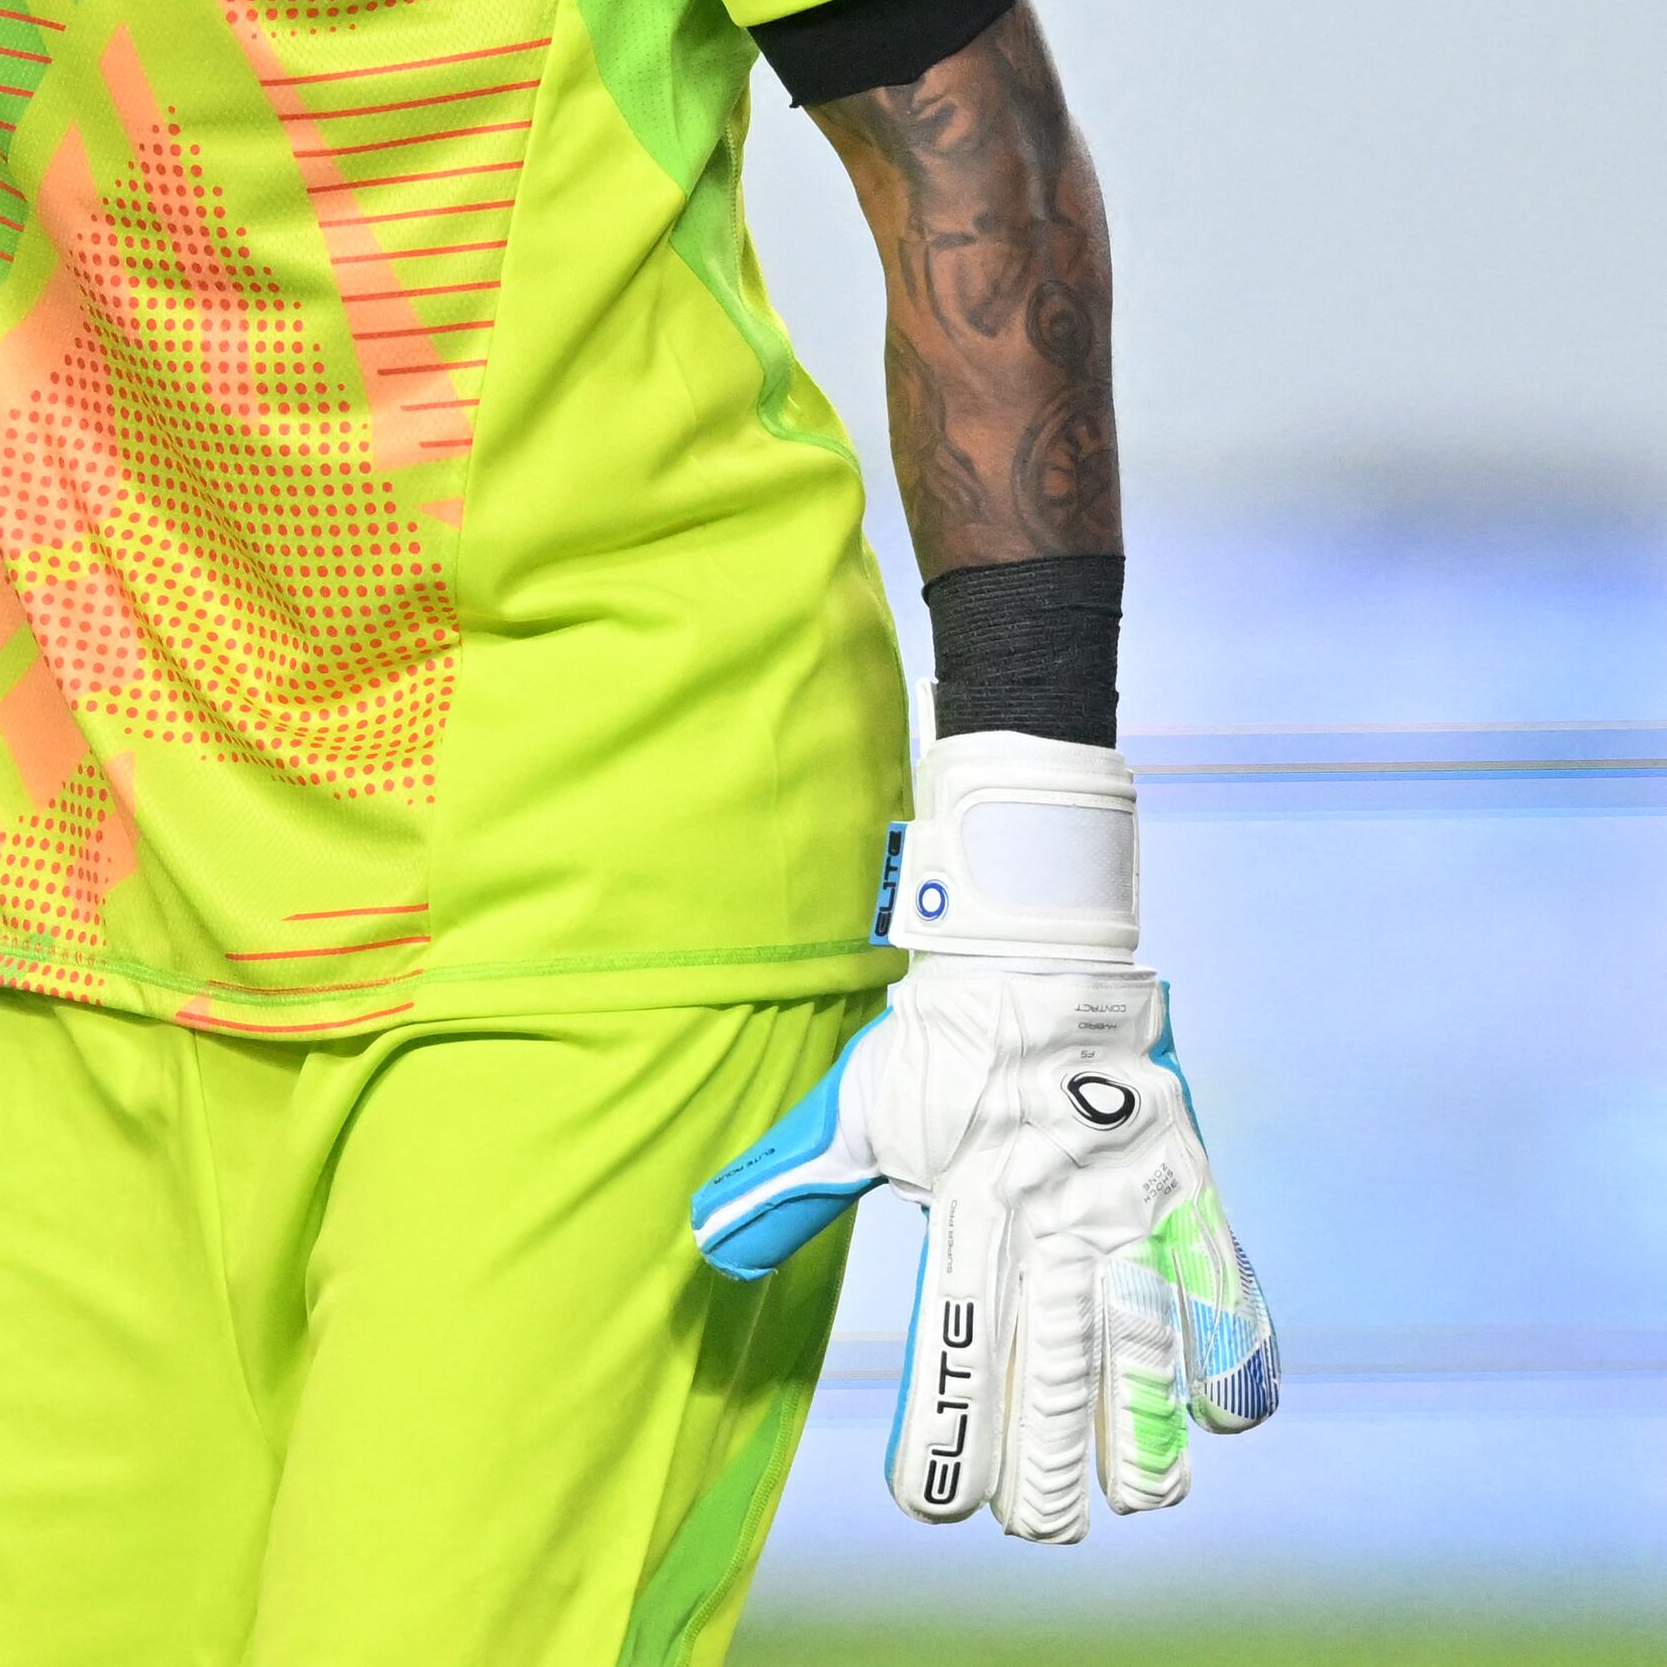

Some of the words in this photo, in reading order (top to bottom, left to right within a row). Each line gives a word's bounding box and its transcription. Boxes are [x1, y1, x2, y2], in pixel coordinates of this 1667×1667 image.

[874, 830, 903, 938] ELITE
[1074, 1003, 1127, 1013] CONTACT
[1078, 1021, 1117, 1030] HYBRID
[923, 1300, 975, 1505] ELITE
